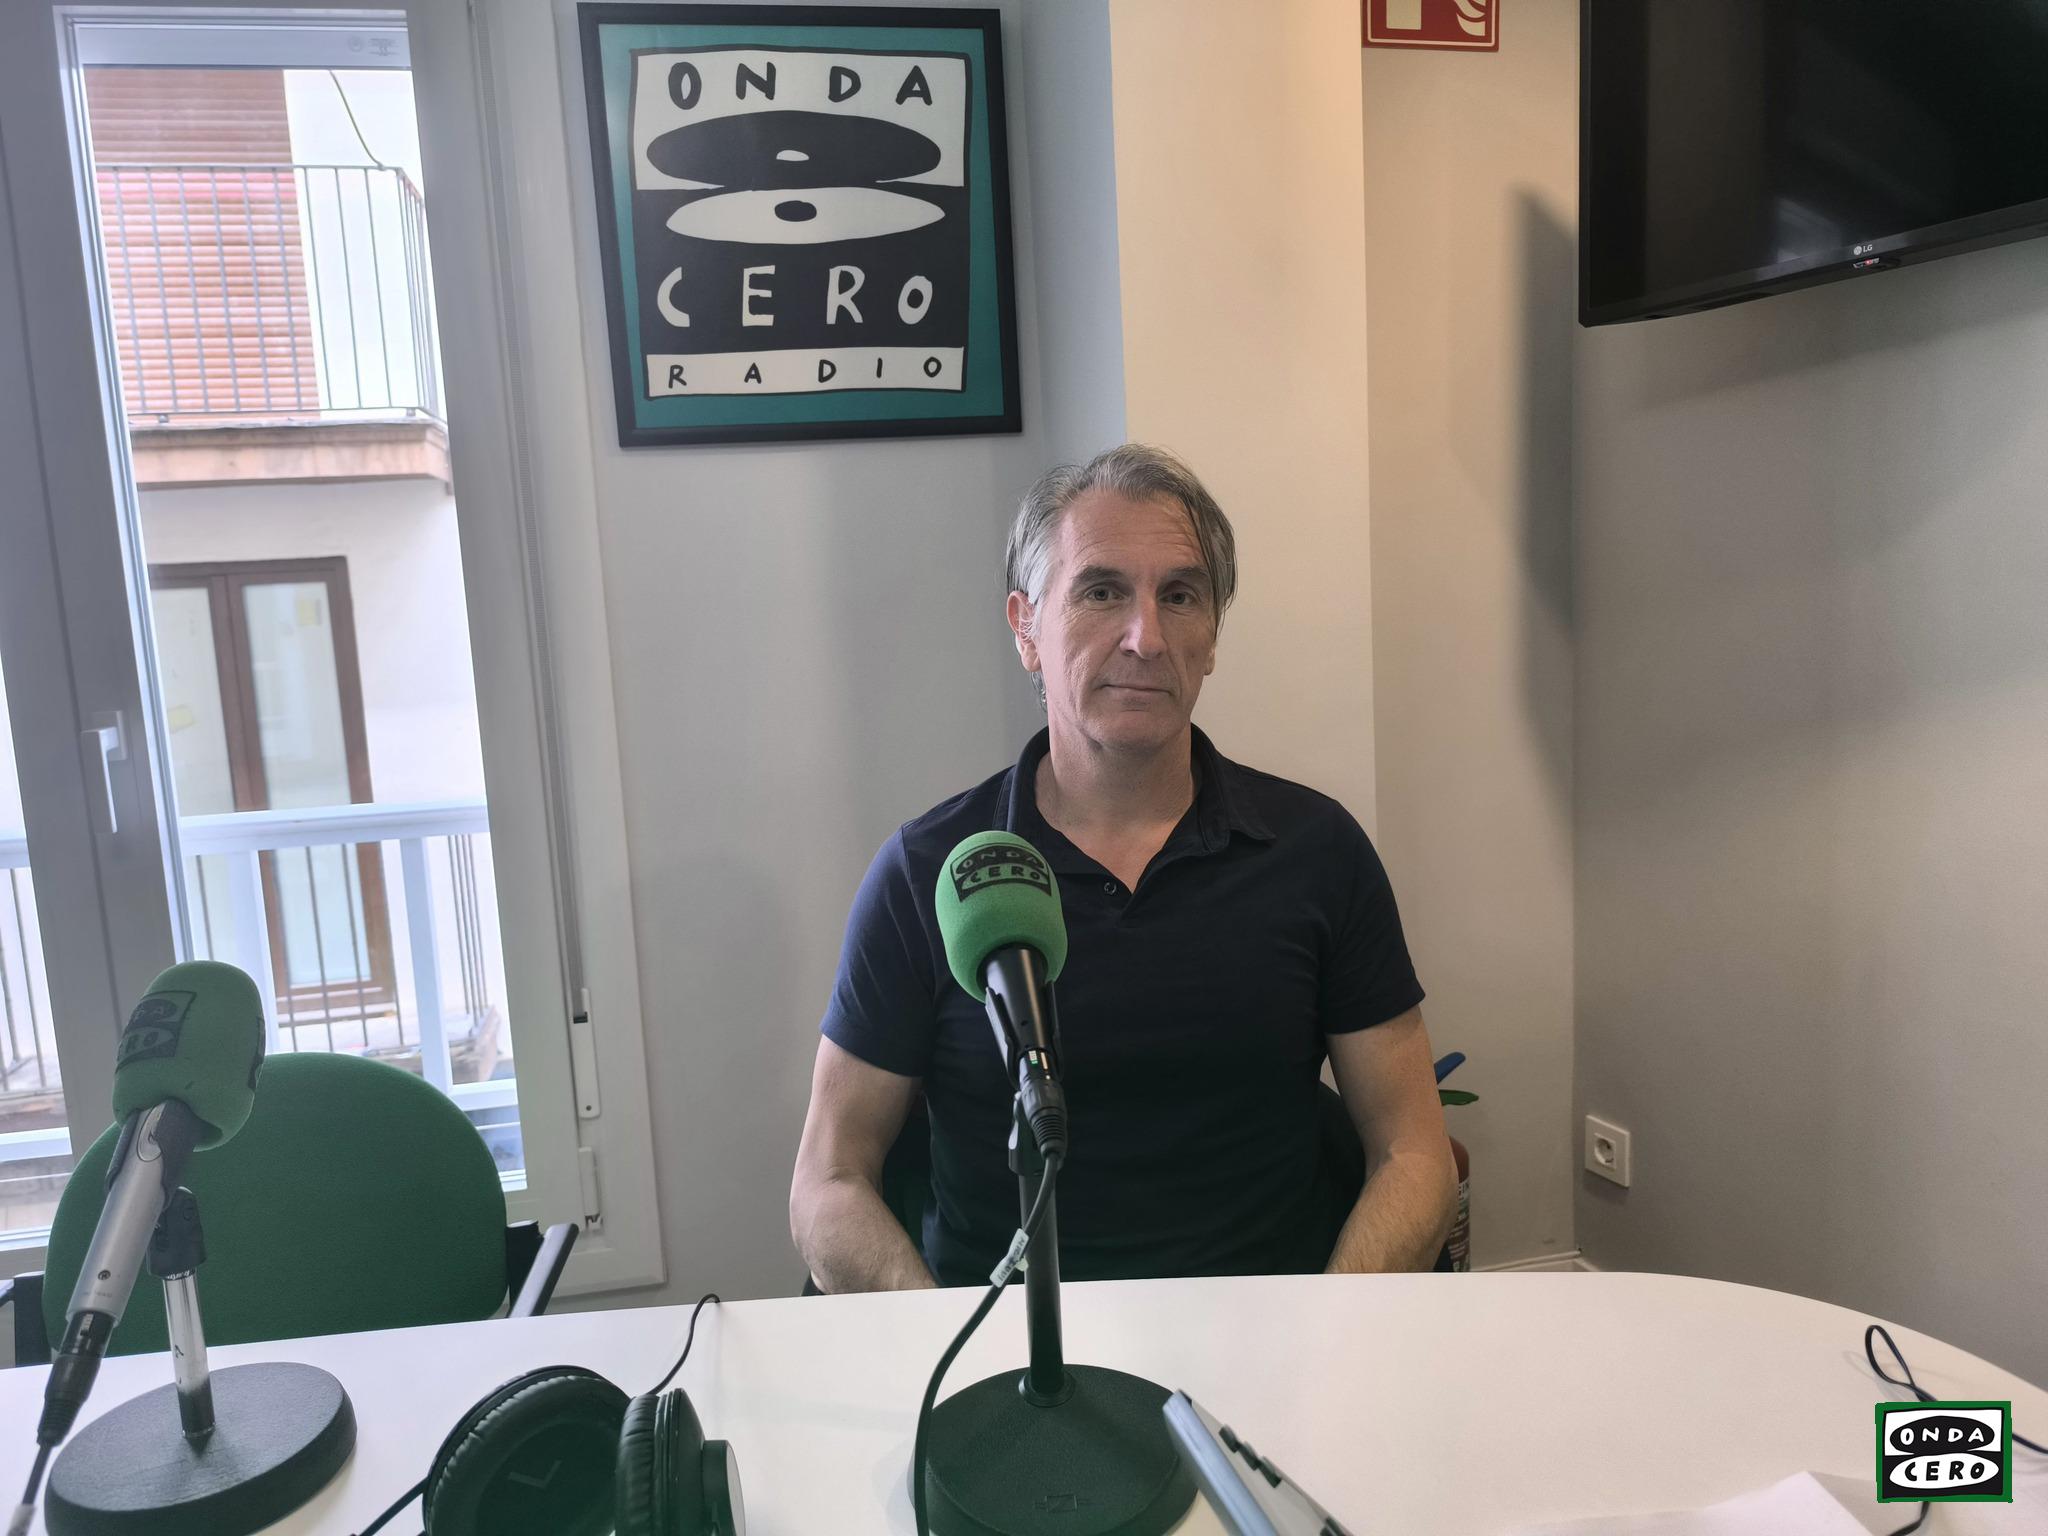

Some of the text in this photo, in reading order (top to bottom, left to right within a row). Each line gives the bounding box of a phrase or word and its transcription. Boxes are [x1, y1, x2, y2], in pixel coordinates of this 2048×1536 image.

[668, 61, 933, 110] ONDA
[656, 265, 933, 328] CERO
[668, 357, 942, 389] RADIO
[963, 850, 1038, 868] ONDA
[970, 865, 1041, 883] CERO
